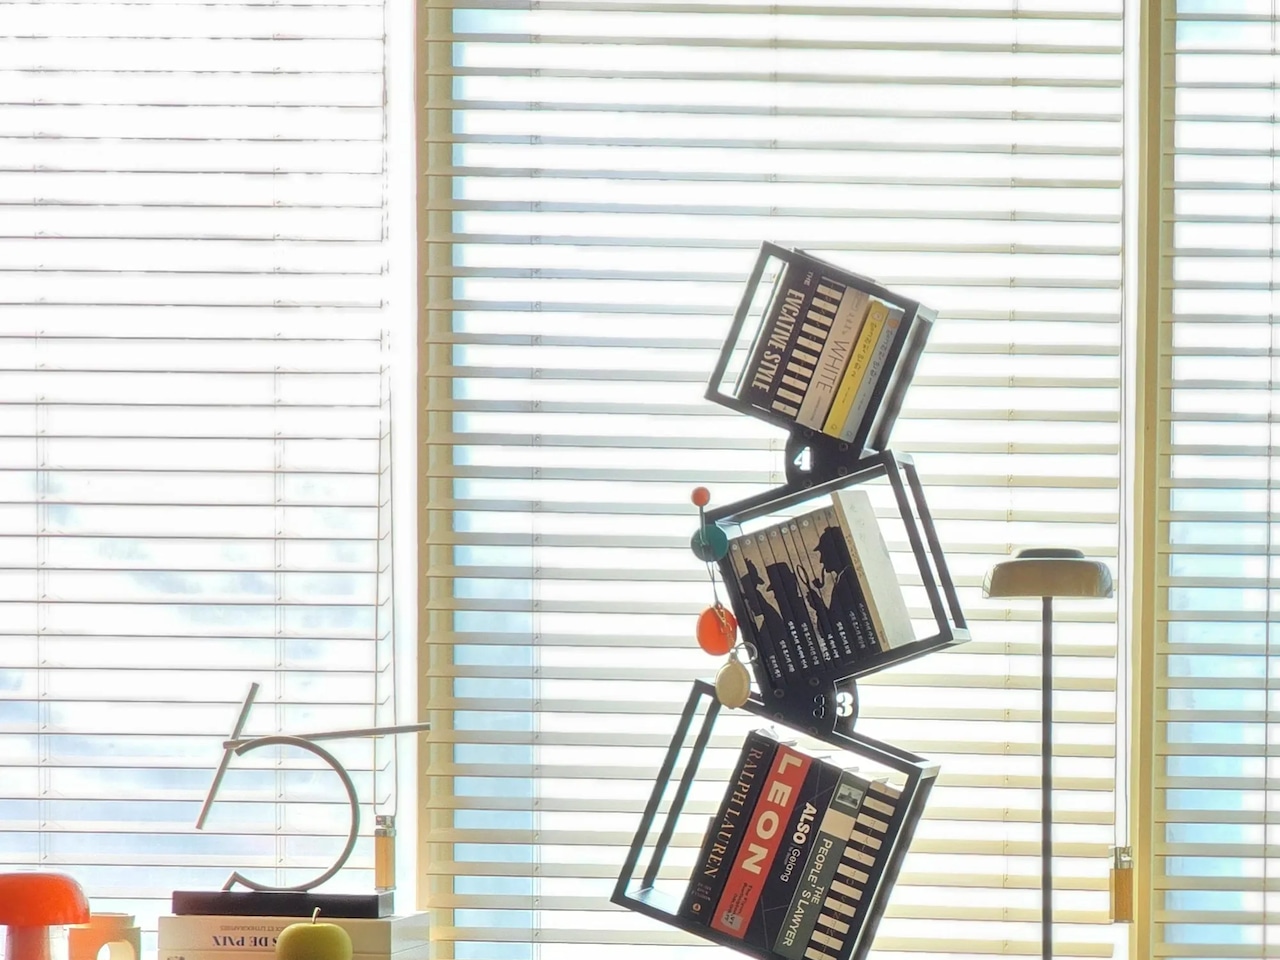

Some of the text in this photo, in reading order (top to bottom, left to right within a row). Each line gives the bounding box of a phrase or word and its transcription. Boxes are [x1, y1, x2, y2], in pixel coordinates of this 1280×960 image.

[803, 270, 813, 285] THE
[750, 349, 781, 392] STYLE
[815, 336, 849, 394] WHITE
[794, 447, 812, 471] 4
[836, 691, 853, 717] 3
[731, 748, 758, 806] RALPH
[742, 753, 802, 875] LEON
[790, 801, 819, 846] ALSO
[703, 806, 740, 878] LAUREN
[779, 846, 801, 882] Gelang
[810, 884, 824, 904] THE
[250, 937, 268, 946] DE
[781, 898, 809, 947] LAWYER
